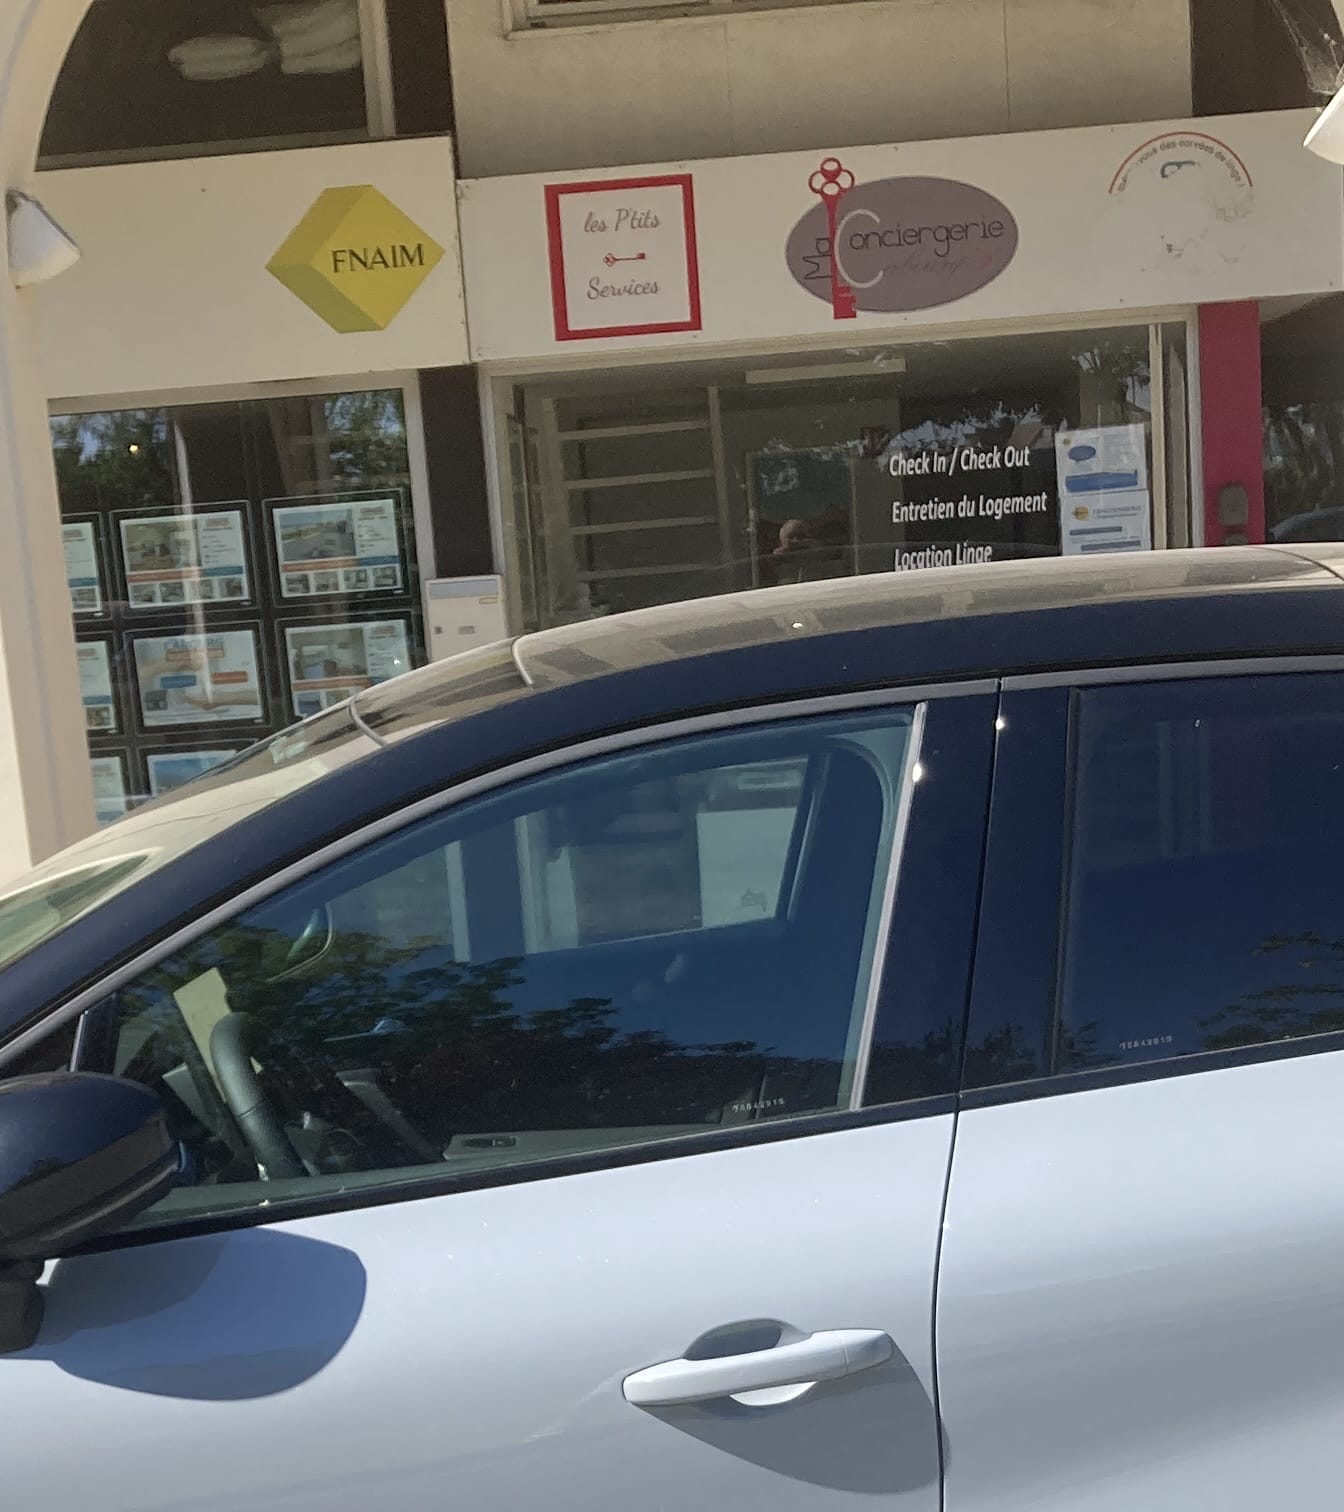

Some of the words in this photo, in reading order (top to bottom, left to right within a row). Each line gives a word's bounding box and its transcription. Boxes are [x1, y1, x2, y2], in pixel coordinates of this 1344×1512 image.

[583, 209, 608, 234] les
[331, 242, 426, 274] FNAIM
[585, 276, 662, 302] Services
[889, 451, 931, 477] Check
[933, 454, 947, 474] In
[948, 447, 958, 477] /
[960, 446, 1002, 472] Check
[1004, 445, 1031, 468] Out
[891, 497, 955, 524] Entretien
[957, 494, 977, 519] du
[978, 490, 1049, 522] Logement
[894, 544, 953, 572] Location
